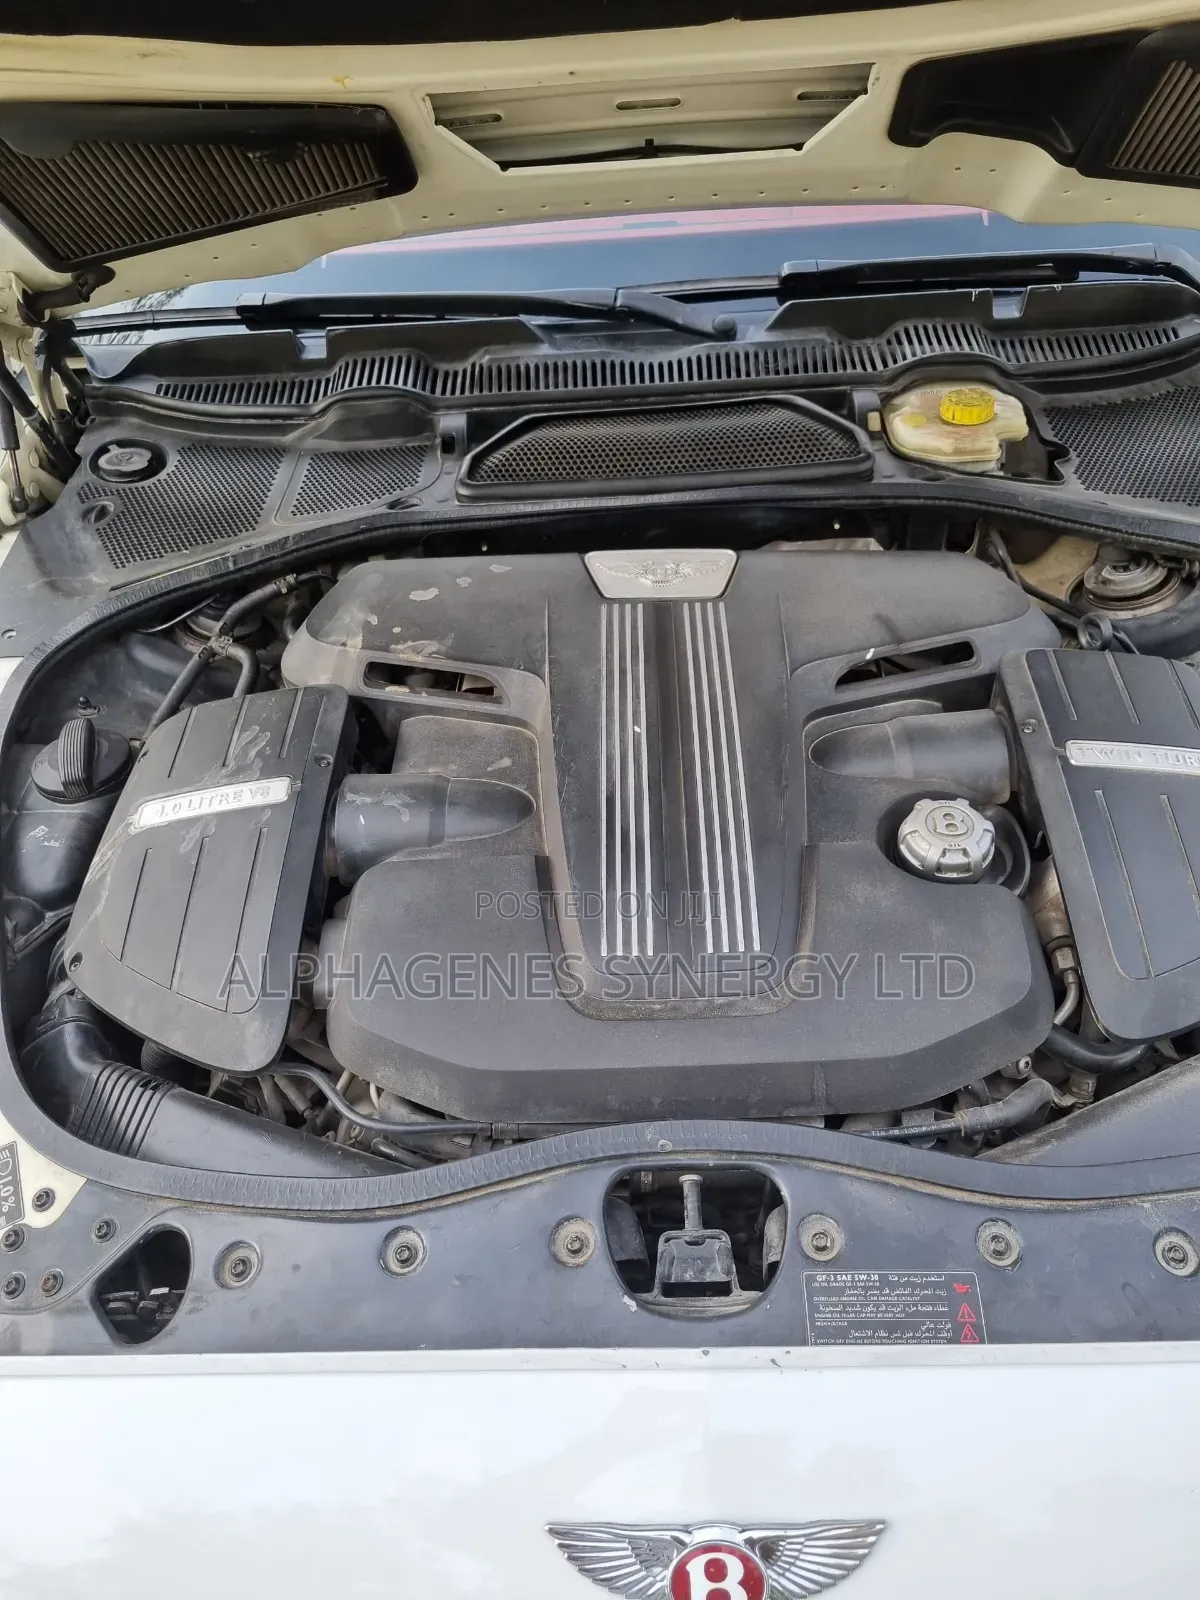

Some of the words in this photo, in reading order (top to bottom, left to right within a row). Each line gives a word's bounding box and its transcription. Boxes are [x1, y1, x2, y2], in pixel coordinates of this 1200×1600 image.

[1076, 744, 1144, 764] TWIN
[1151, 751, 1200, 768] TUR
[187, 790, 243, 810] LITRE
[816, 1274, 835, 1282] GF-3
